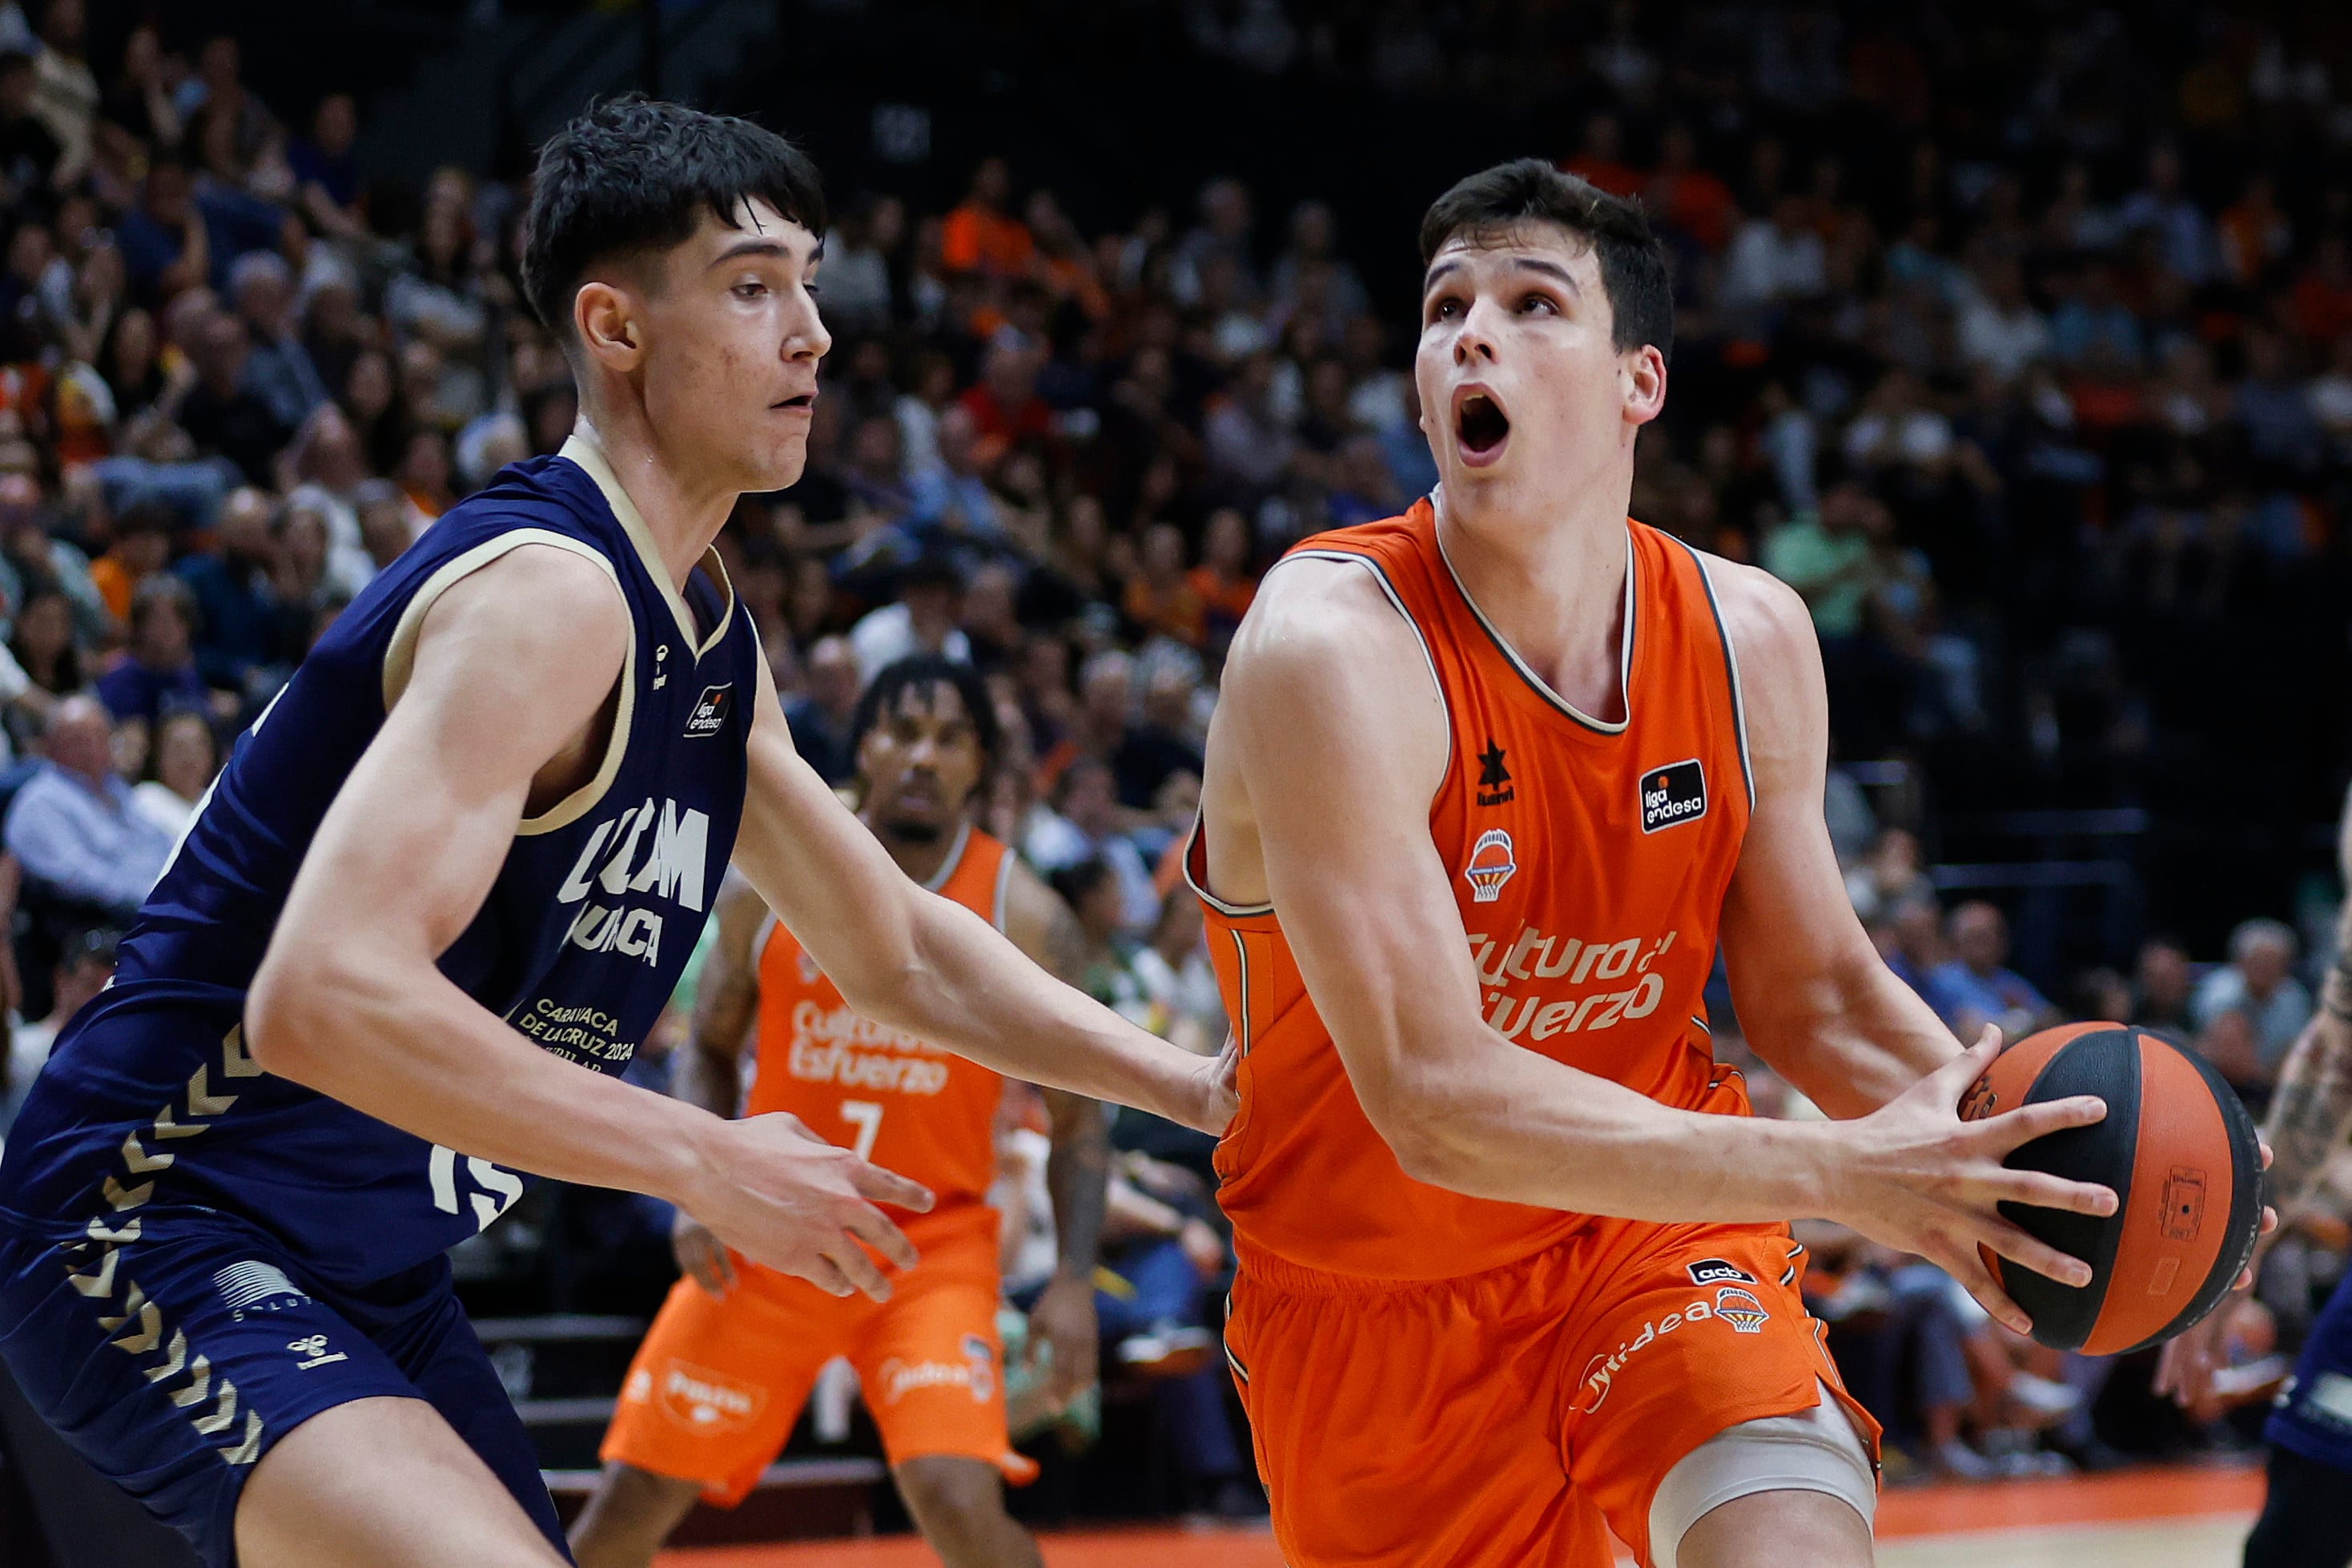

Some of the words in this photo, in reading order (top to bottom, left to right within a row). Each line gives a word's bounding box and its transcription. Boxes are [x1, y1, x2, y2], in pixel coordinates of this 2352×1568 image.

[1645, 789, 1668, 809] liga
[1646, 796, 1703, 824] endesa
[536, 998, 619, 1037] CARAVACA
[519, 1012, 549, 1036] DE
[541, 1027, 562, 1043] LA
[560, 1027, 607, 1057] CRUZ
[602, 1042, 636, 1062] 2024
[840, 1098, 883, 1163] 7
[1698, 1266, 1743, 1280] acb
